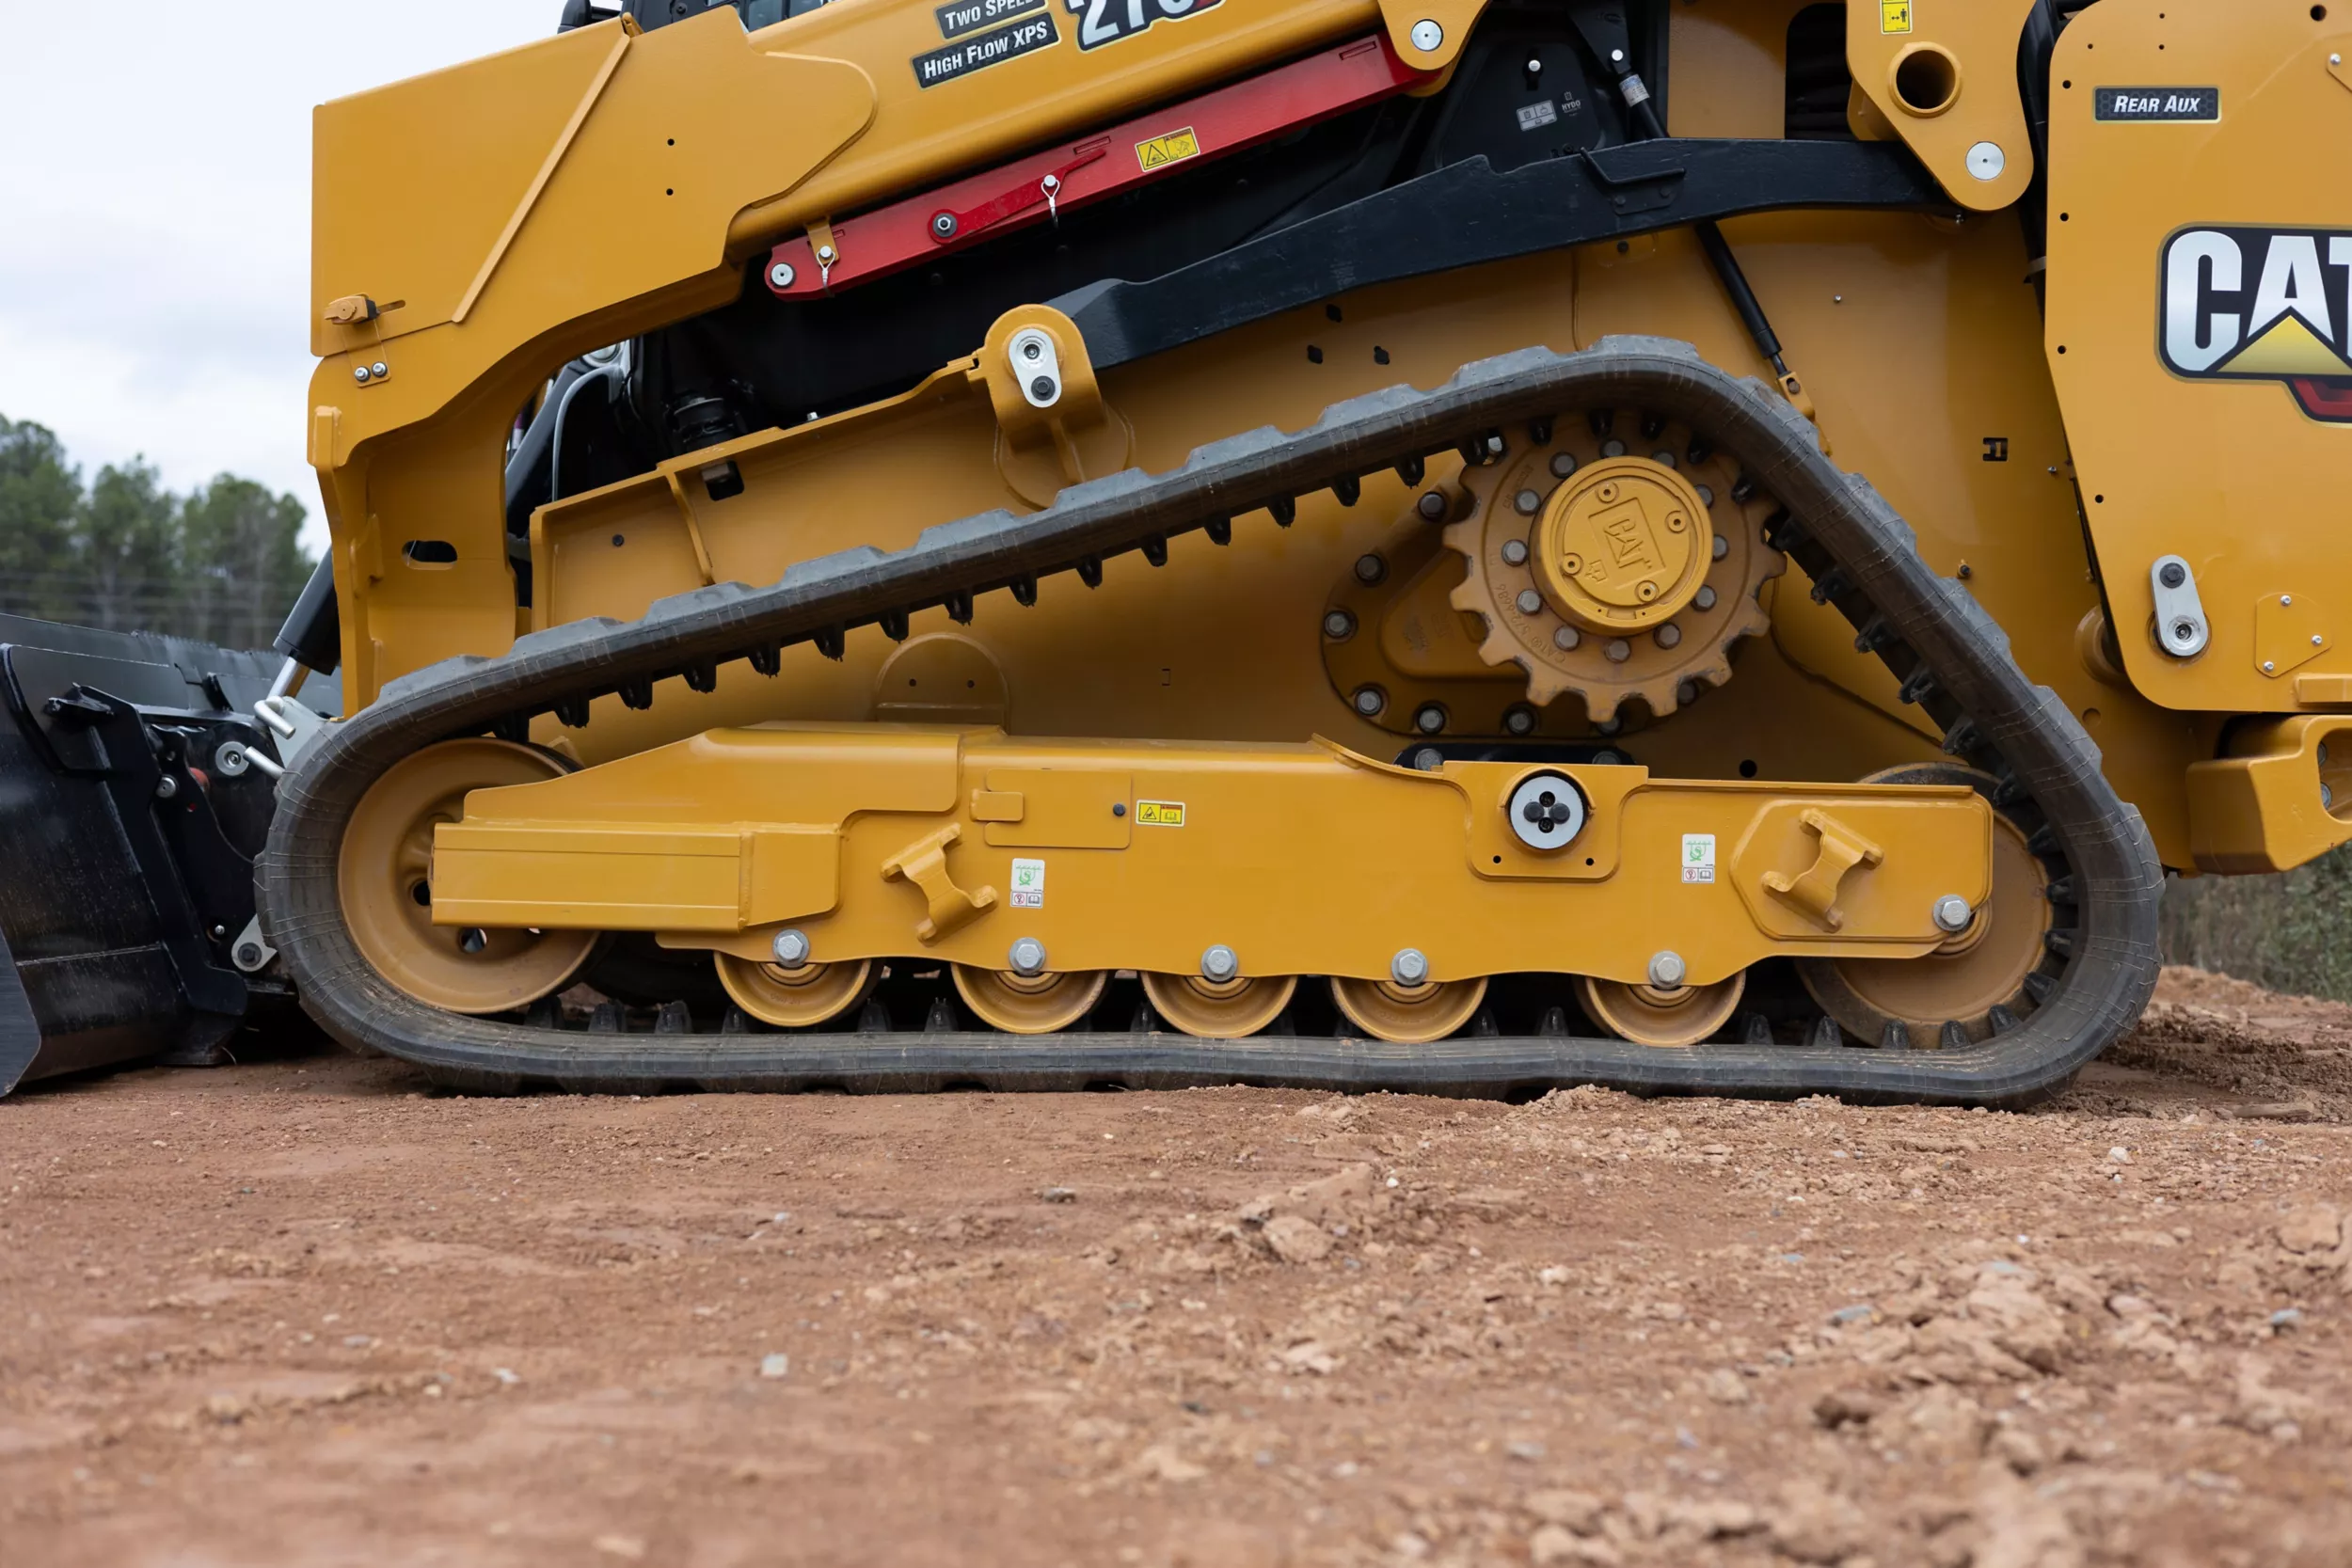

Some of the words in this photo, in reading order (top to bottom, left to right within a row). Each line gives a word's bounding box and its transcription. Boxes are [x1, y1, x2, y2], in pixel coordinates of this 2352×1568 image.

[924, 53, 962, 79] HIGH
[966, 37, 1009, 64] FLOW
[1012, 21, 1048, 49] XPS
[2113, 95, 2161, 113] REAR
[2164, 95, 2201, 113] AUX
